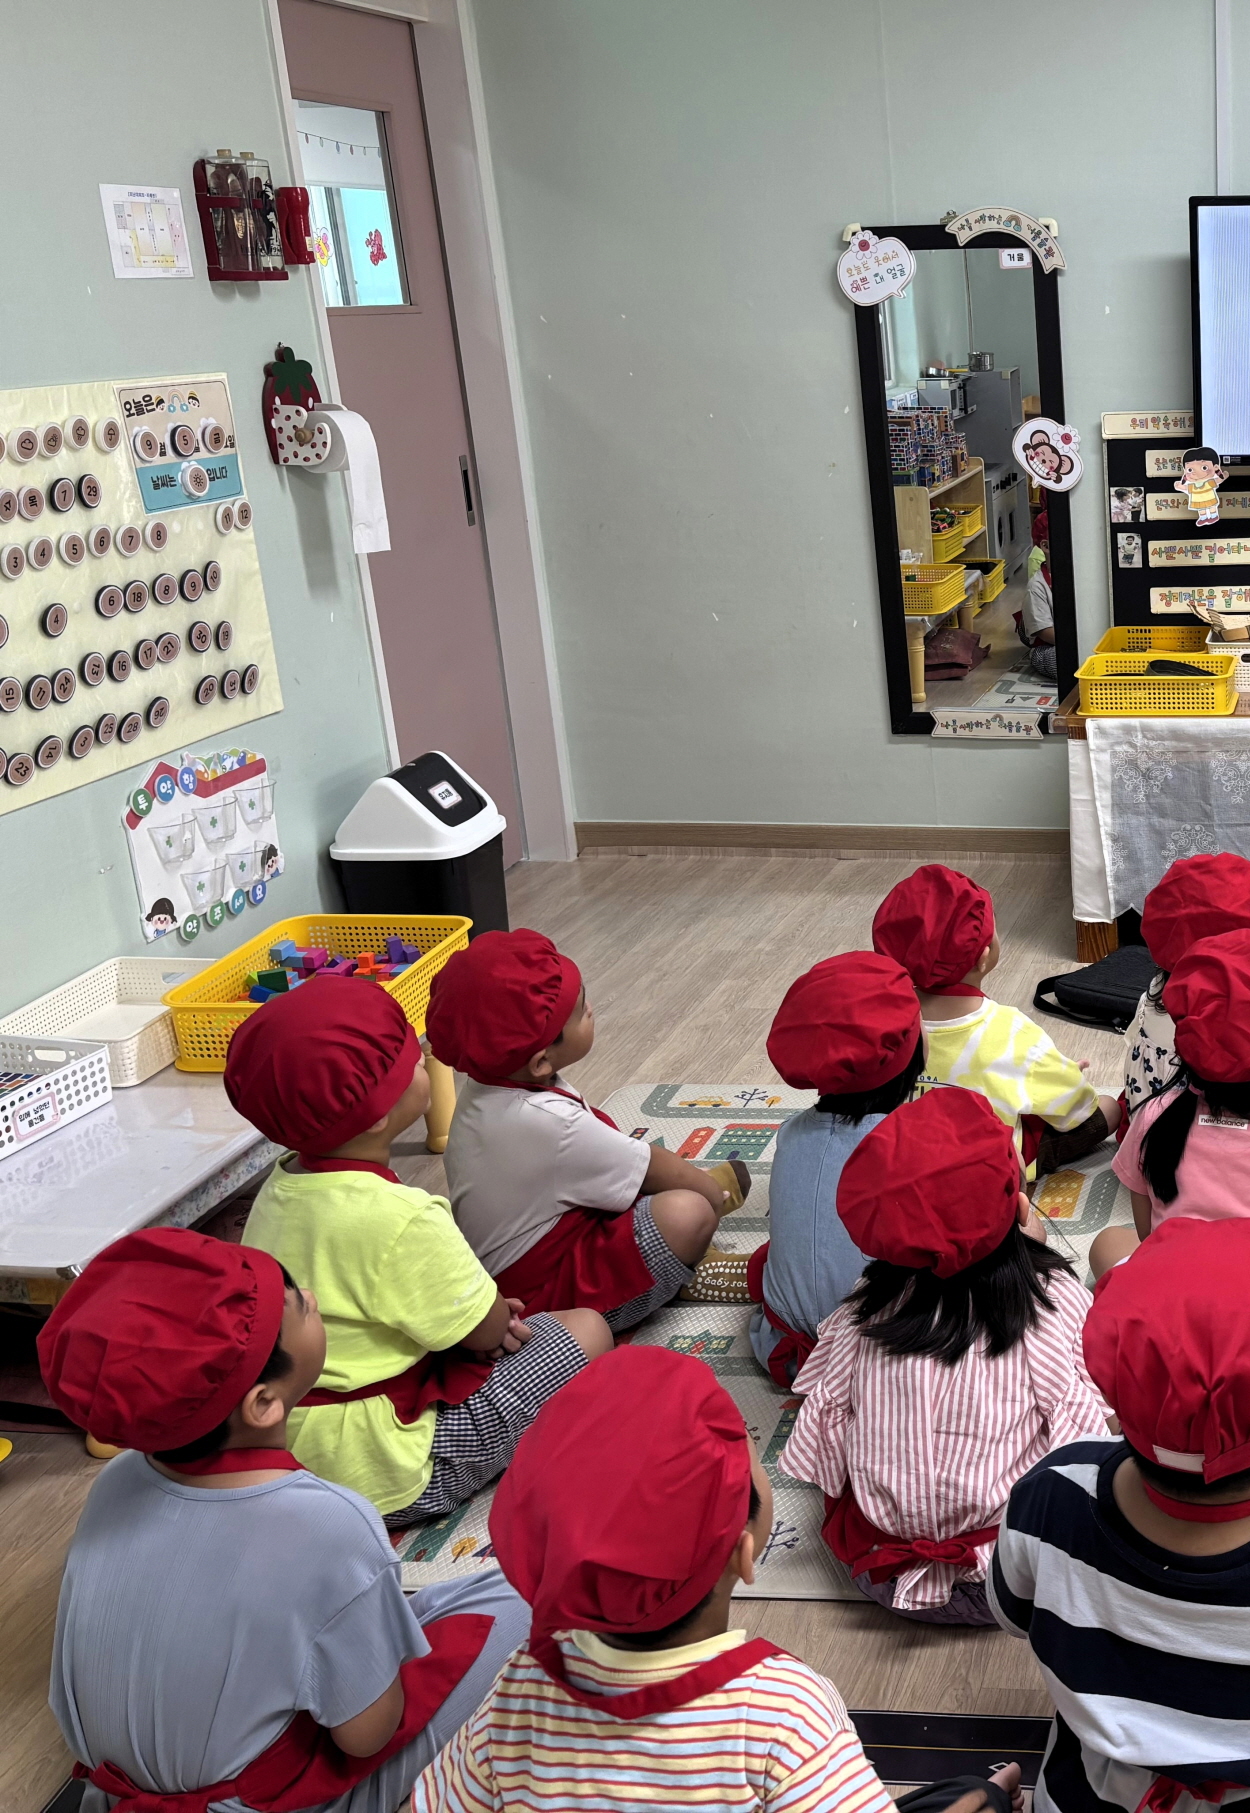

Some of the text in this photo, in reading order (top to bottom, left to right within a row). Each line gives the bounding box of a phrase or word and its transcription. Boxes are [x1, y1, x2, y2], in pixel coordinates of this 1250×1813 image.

[1007, 252, 1024, 262] 거울
[846, 260, 871, 278] 오늘도
[850, 263, 906, 293] 예쁜 내 얼굴
[124, 394, 156, 418] 오늘은
[1130, 417, 1148, 430] 우리
[145, 439, 153, 450] 9
[182, 435, 189, 446] 5
[213, 433, 221, 445] 금
[151, 466, 228, 491] 날씨는 입니다
[61, 490, 67, 501] 7
[86, 485, 97, 497] 29
[12, 509, 249, 568] 3 4 5 6 7 8 11 12
[53, 570, 218, 624] 4 6 18 8 9 10
[1159, 589, 1217, 608] 정리정돈을
[5, 687, 15, 703] 15
[59, 676, 71, 693] 24
[91, 663, 100, 676] 13
[118, 660, 127, 672] 16
[143, 647, 153, 660] 17
[162, 641, 175, 655] 21
[196, 630, 207, 644] 30
[14, 762, 30, 777] 23
[80, 736, 88, 747] 3
[103, 723, 113, 734] 25
[126, 722, 139, 733] 28
[203, 683, 214, 698] 20
[704, 1277, 729, 1288] baby
